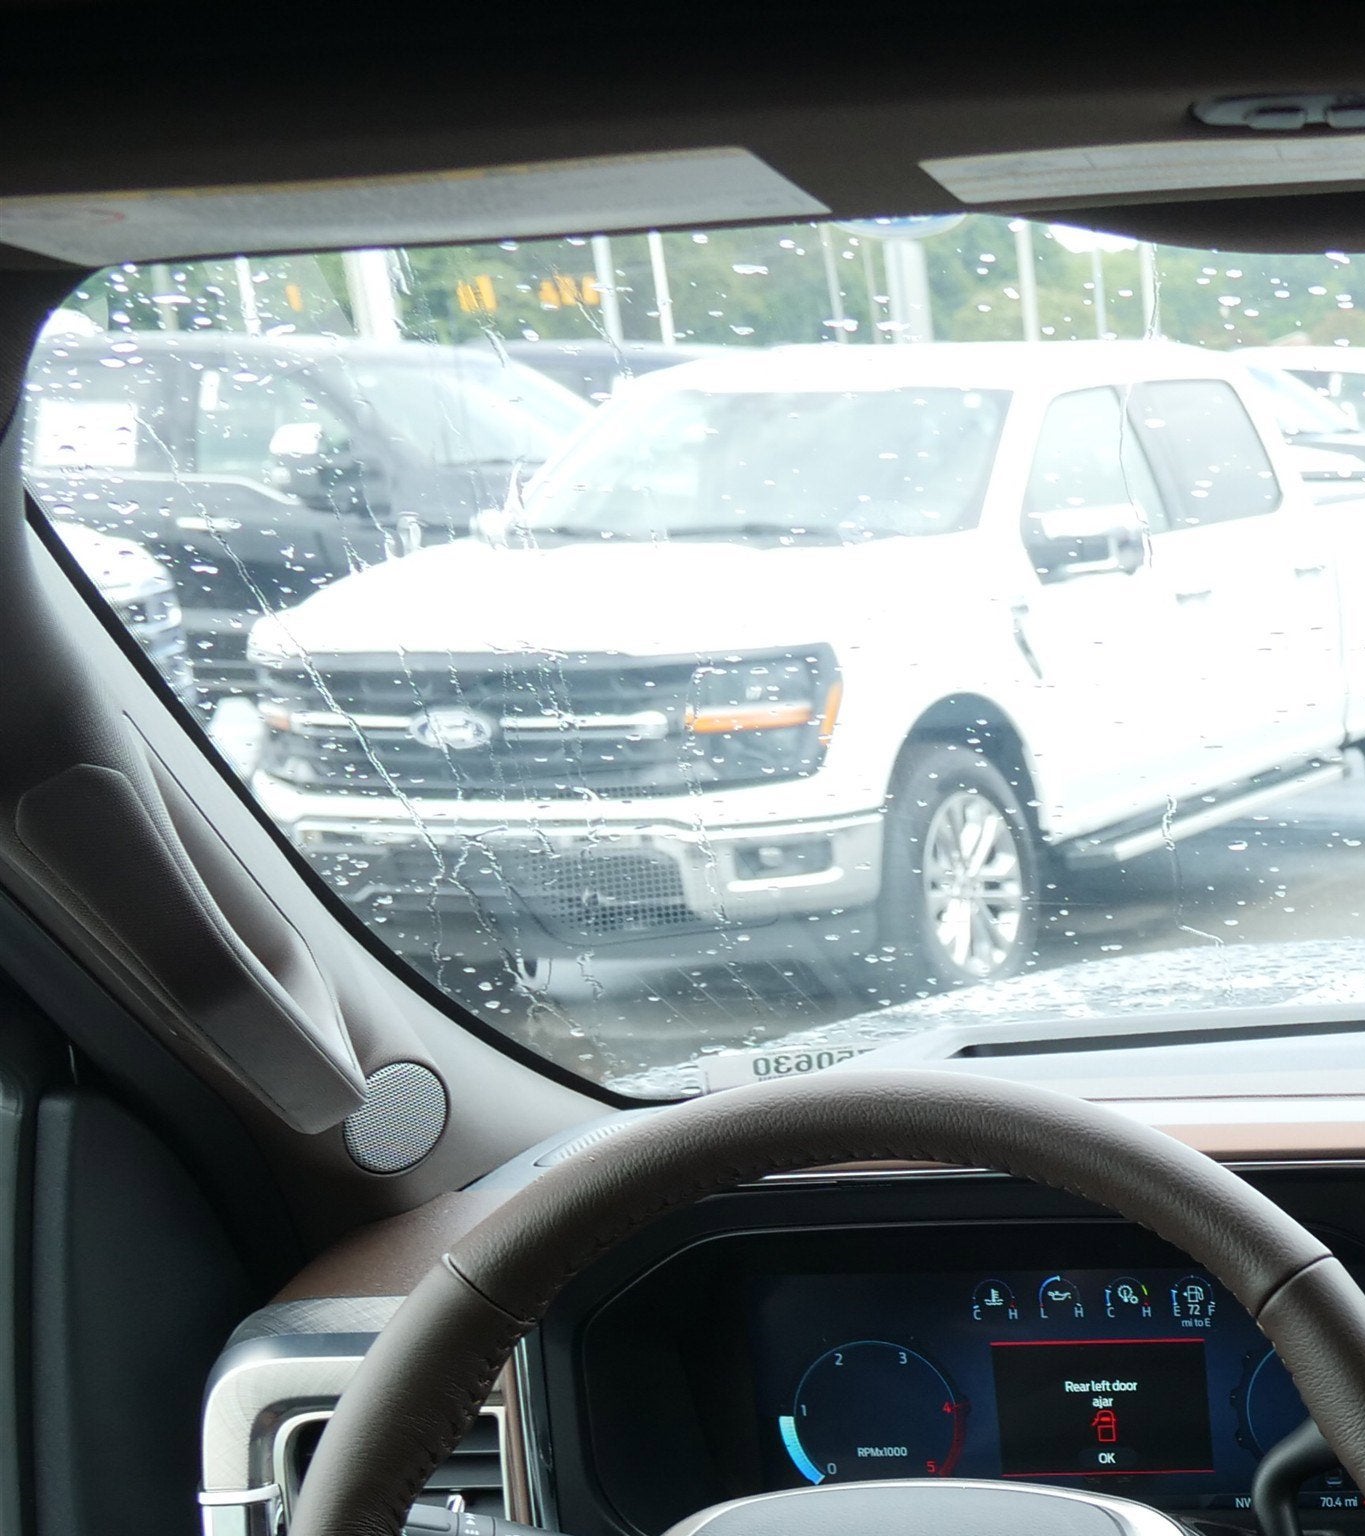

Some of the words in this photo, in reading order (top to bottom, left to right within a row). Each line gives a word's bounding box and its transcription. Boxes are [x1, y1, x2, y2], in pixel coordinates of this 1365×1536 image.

[973, 1309, 982, 1320] C
[1008, 1308, 1018, 1320] H
[1040, 1308, 1048, 1319] L
[1074, 1308, 1084, 1318] H
[1107, 1307, 1115, 1318] C
[1142, 1307, 1152, 1317] H
[1173, 1306, 1181, 1317] E
[1188, 1304, 1201, 1315] 72
[1208, 1306, 1216, 1316] F
[1181, 1319, 1194, 1327] mi
[1195, 1318, 1204, 1327] to
[834, 1353, 844, 1365] 2
[899, 1352, 908, 1364] 3
[1065, 1381, 1090, 1392] Rear
[1091, 1380, 1111, 1391] left
[1112, 1380, 1137, 1391] door
[942, 1402, 952, 1413] 4
[1092, 1396, 1113, 1408] ajar
[801, 1404, 807, 1416] 1
[857, 1447, 907, 1457] RPMx1000
[1098, 1453, 1116, 1464] OK
[827, 1462, 837, 1475] 0
[926, 1461, 936, 1473] 5
[1321, 1497, 1341, 1507] 70.4
[1345, 1497, 1357, 1507] mi
